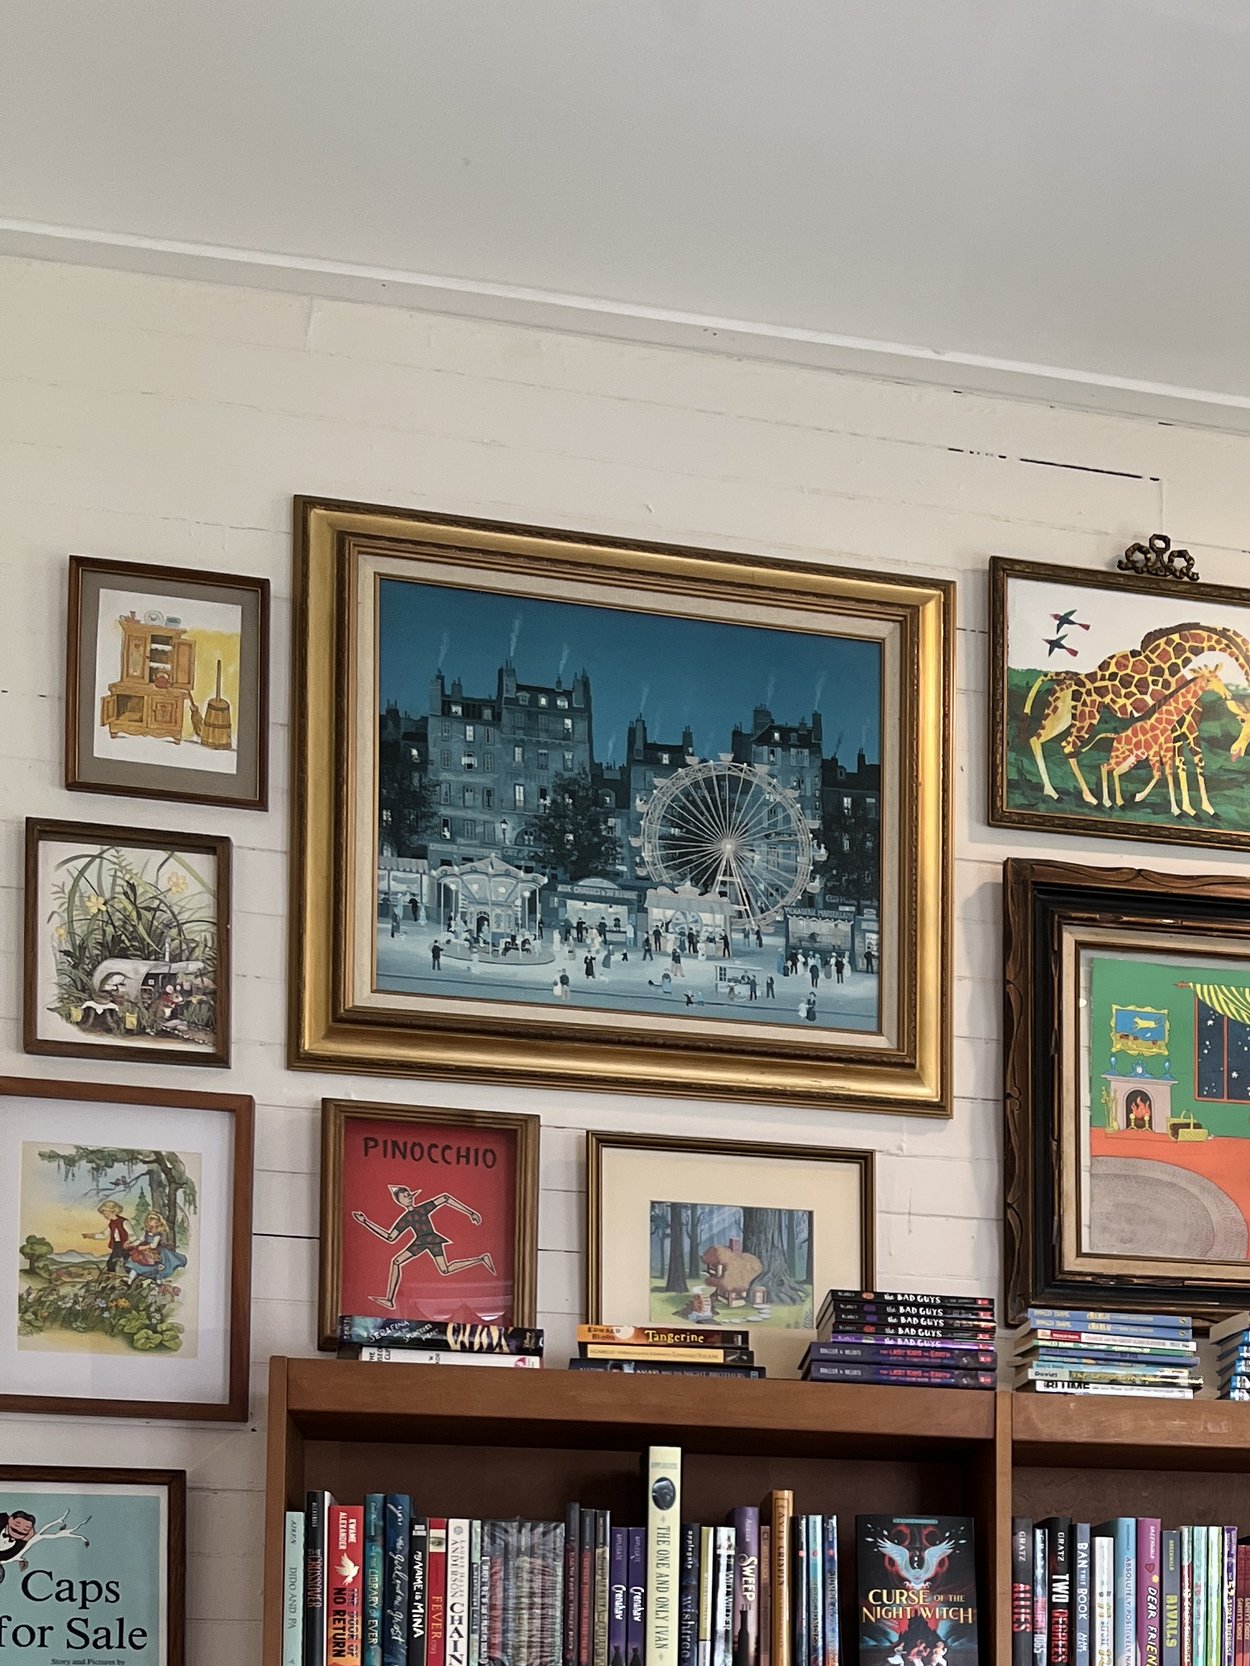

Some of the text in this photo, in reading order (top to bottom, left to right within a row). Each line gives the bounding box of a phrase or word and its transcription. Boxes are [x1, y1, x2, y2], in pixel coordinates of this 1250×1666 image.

[363, 1137, 497, 1169] PINOCCHIO
[884, 1293, 941, 1304] the BAD GUYS
[645, 1330, 704, 1343] Tangerine
[1057, 1531, 1065, 1562] GRATZ
[21, 1570, 120, 1609] Caps
[655, 1526, 670, 1650] THE ONE AND ONLY IVAN
[740, 1555, 758, 1602] SWEEP
[1051, 1573, 1070, 1603] TWO
[868, 1589, 965, 1606] CURSE OF THE
[1147, 1586, 1158, 1620] DEAR
[332, 1587, 346, 1658] NO RETURN
[862, 1606, 973, 1624] NIGHT WITCH
[0, 1615, 147, 1650] for Sale
